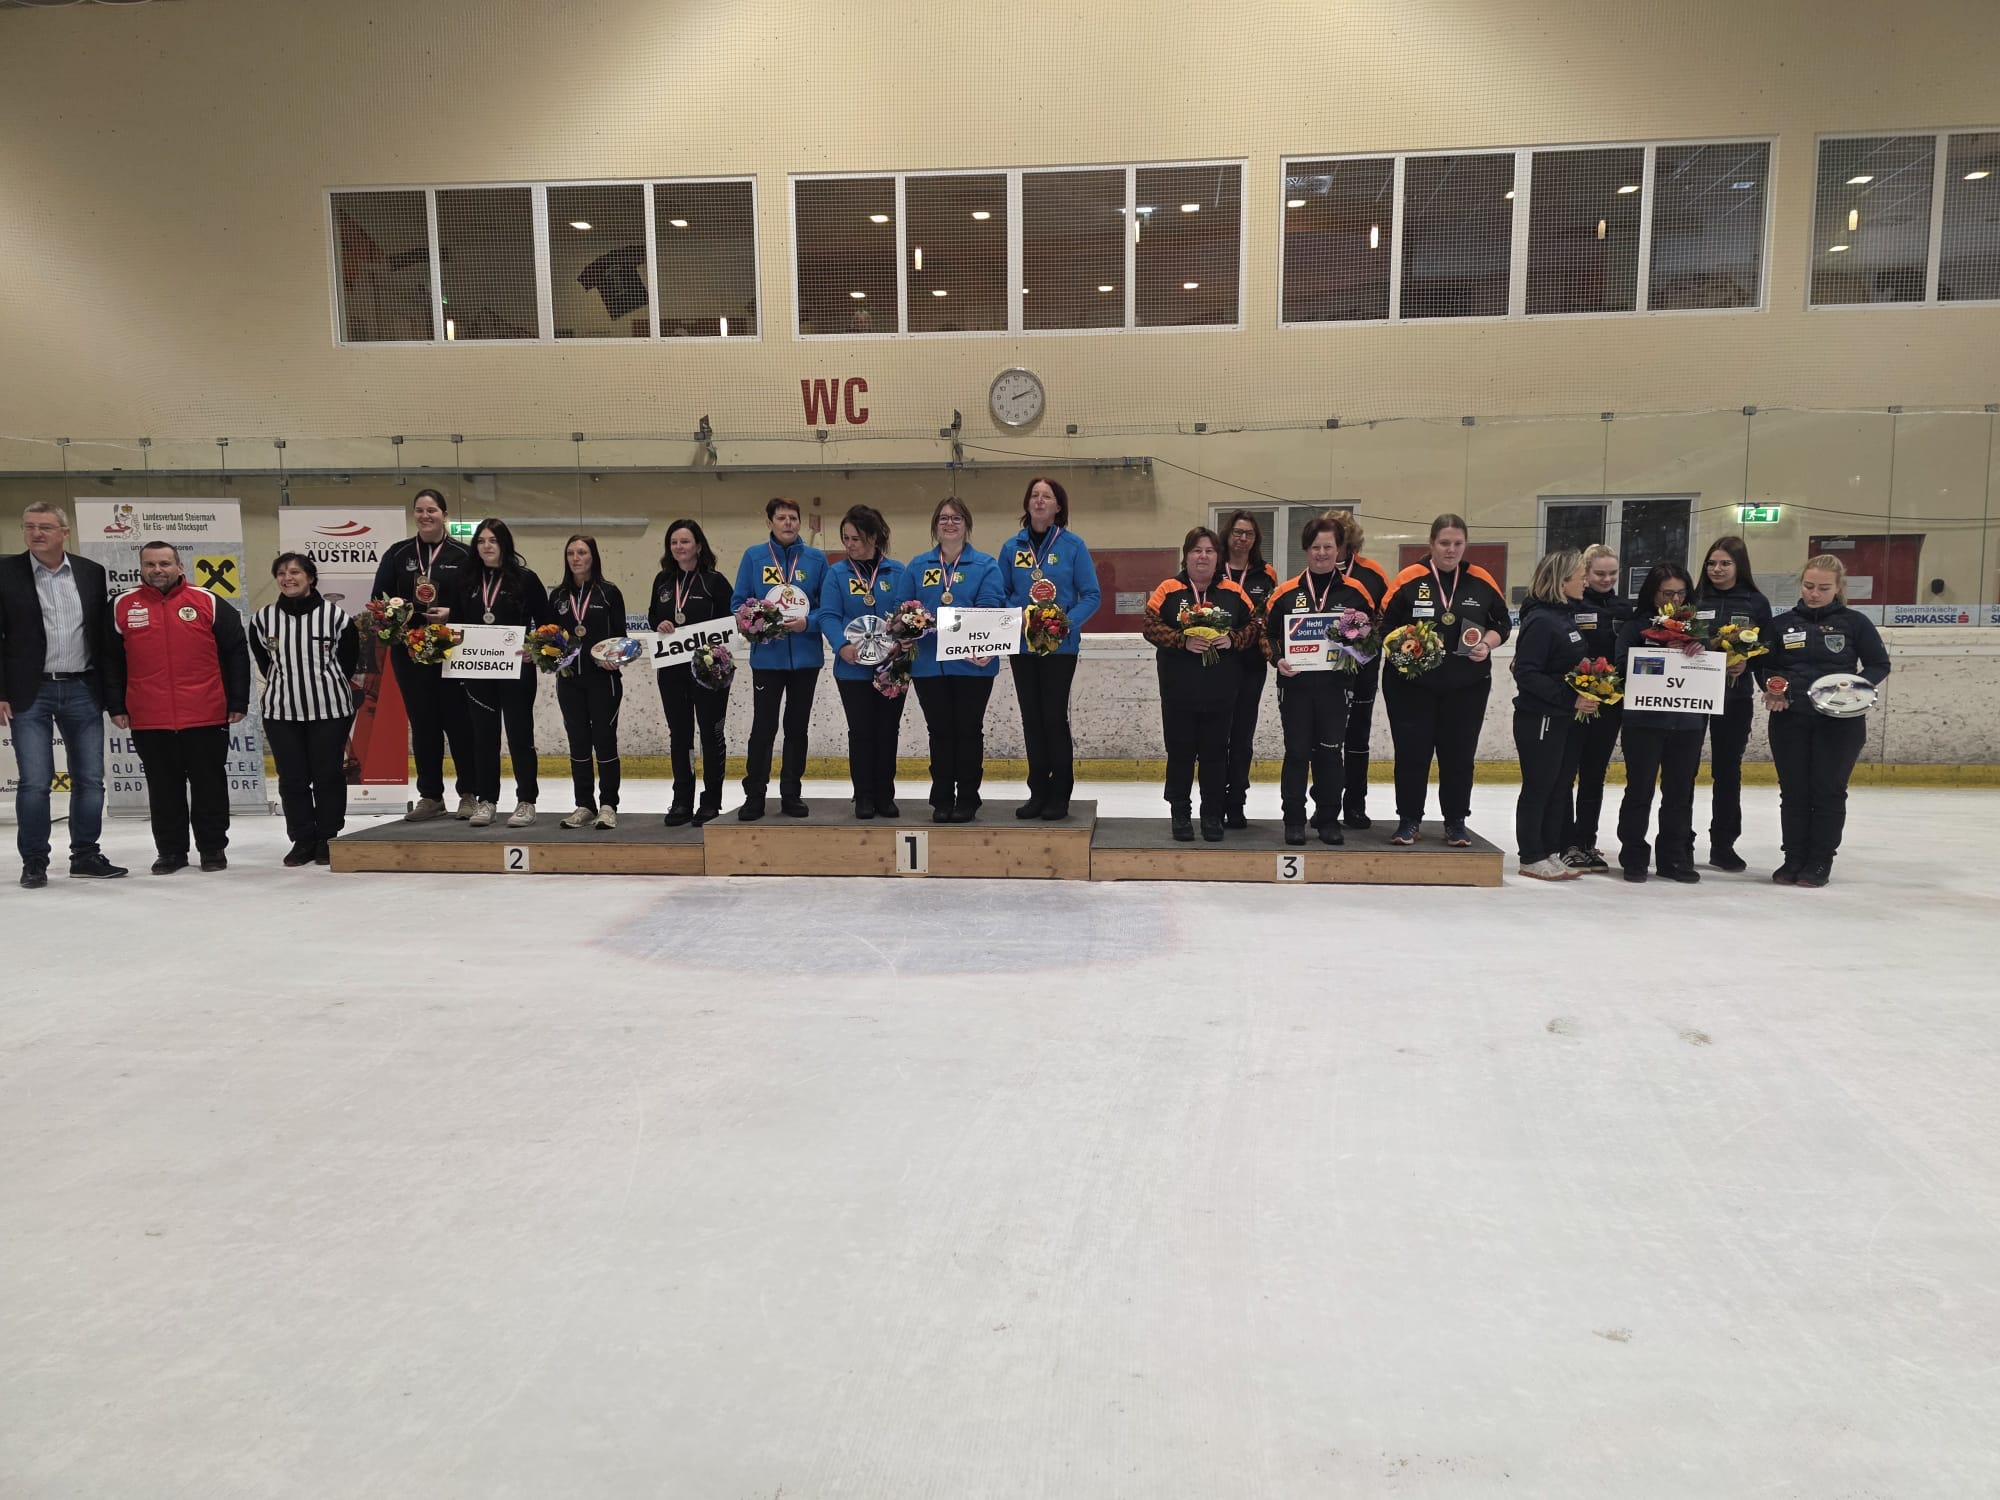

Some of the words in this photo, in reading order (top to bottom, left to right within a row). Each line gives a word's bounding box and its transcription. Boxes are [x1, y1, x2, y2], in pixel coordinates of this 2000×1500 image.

[800, 376, 869, 426] WC
[142, 513, 184, 521] Landesverband
[185, 513, 216, 521] Steiermark
[143, 523, 152, 531] für
[165, 522, 177, 531] und
[177, 523, 208, 532] Stocksport
[304, 541, 379, 550] STOCKSPORT
[307, 550, 378, 562] AUSTRIA
[109, 569, 142, 582] Raif
[1894, 614, 1957, 624] SPARKASSE
[968, 632, 990, 640] HSV
[462, 648, 478, 656] ESV
[480, 648, 505, 656] Union
[945, 642, 1012, 655] GRATKORN
[450, 660, 514, 671] KROISBACH
[1666, 677, 1685, 688] SV
[1634, 696, 1714, 710] HERNSTEIN
[114, 781, 142, 792] BAD
[905, 836, 917, 869] 1
[509, 848, 523, 869] 2
[1283, 856, 1298, 878] 3
